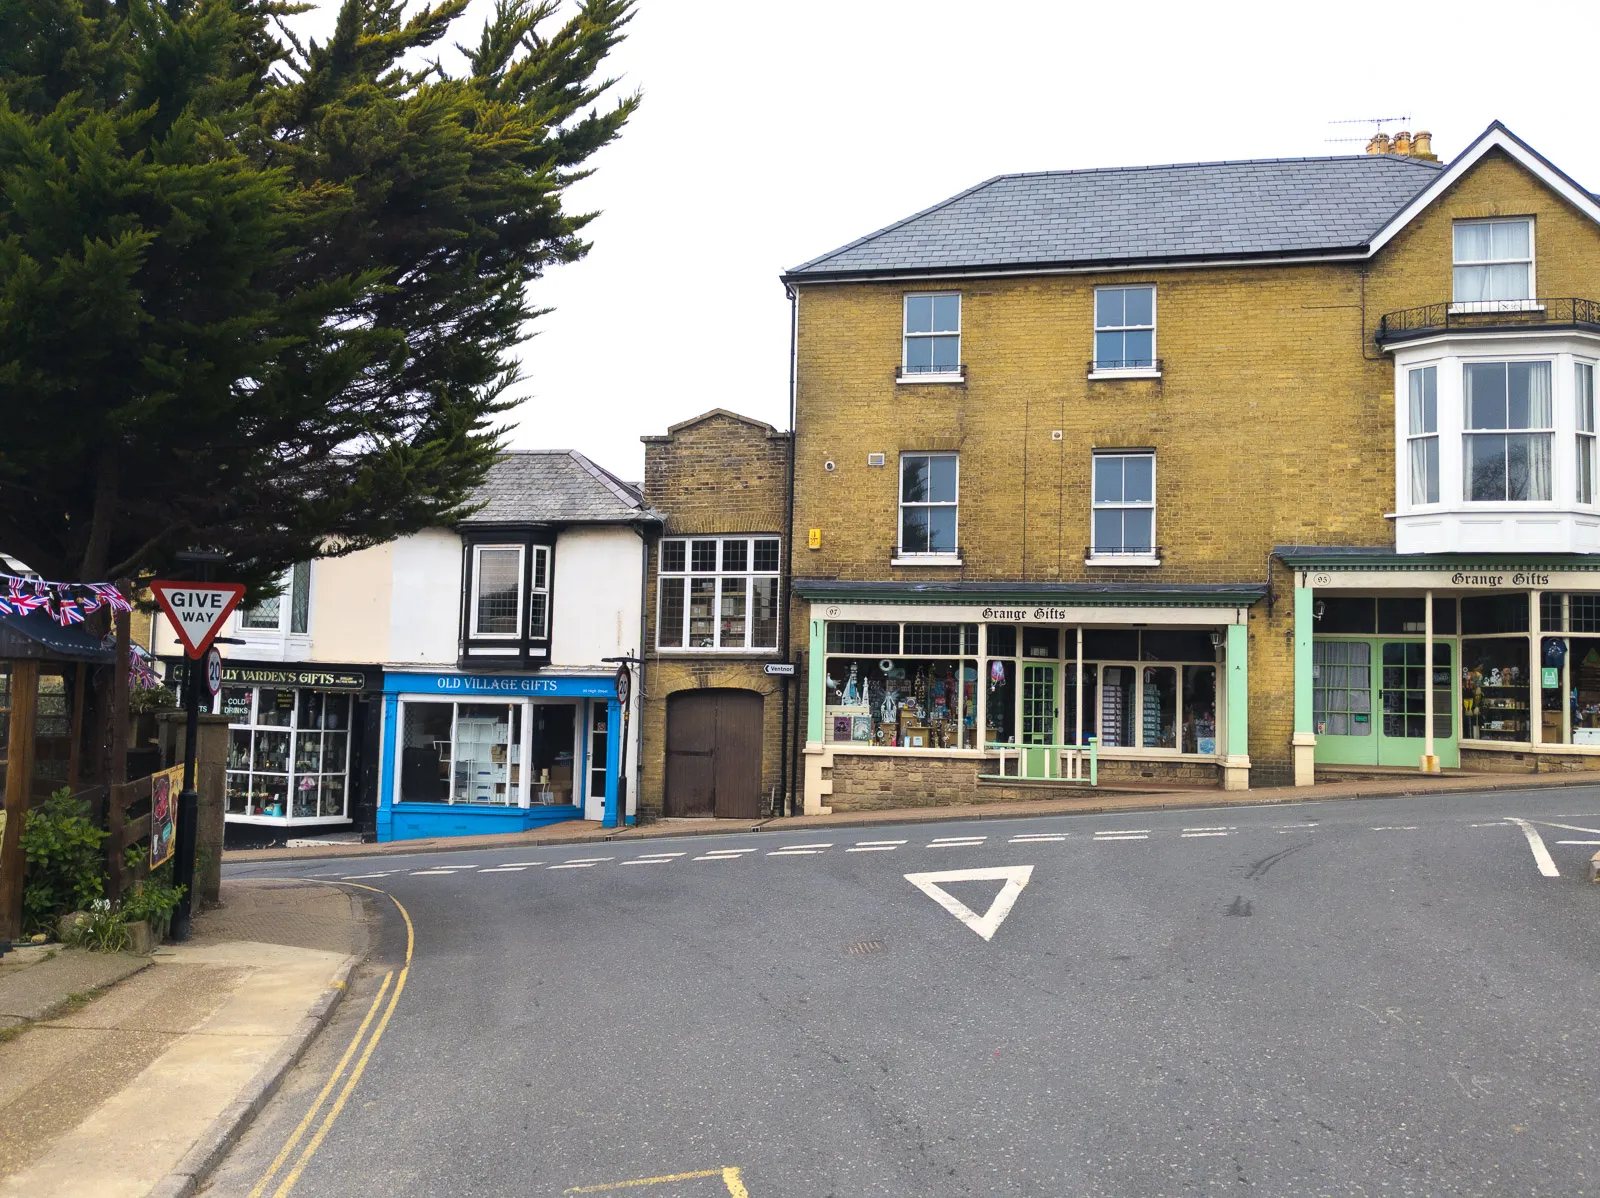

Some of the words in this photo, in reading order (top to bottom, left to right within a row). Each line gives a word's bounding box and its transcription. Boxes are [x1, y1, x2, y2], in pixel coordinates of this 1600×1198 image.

[1451, 572, 1503, 586] Grange
[1512, 572, 1549, 585] Gifts
[170, 591, 222, 608] GIVE
[182, 611, 214, 622] WAY
[982, 607, 1027, 620] Grange
[1033, 607, 1066, 619] Gifts
[209, 661, 220, 681] 20
[241, 670, 297, 682] VARDEN'S
[299, 672, 334, 685] GIFTS
[437, 677, 460, 689] OLD
[464, 677, 518, 690] VILLAGE
[521, 679, 558, 691] GIFTS
[619, 680, 627, 695] 20
[224, 706, 249, 714] DRINKS
